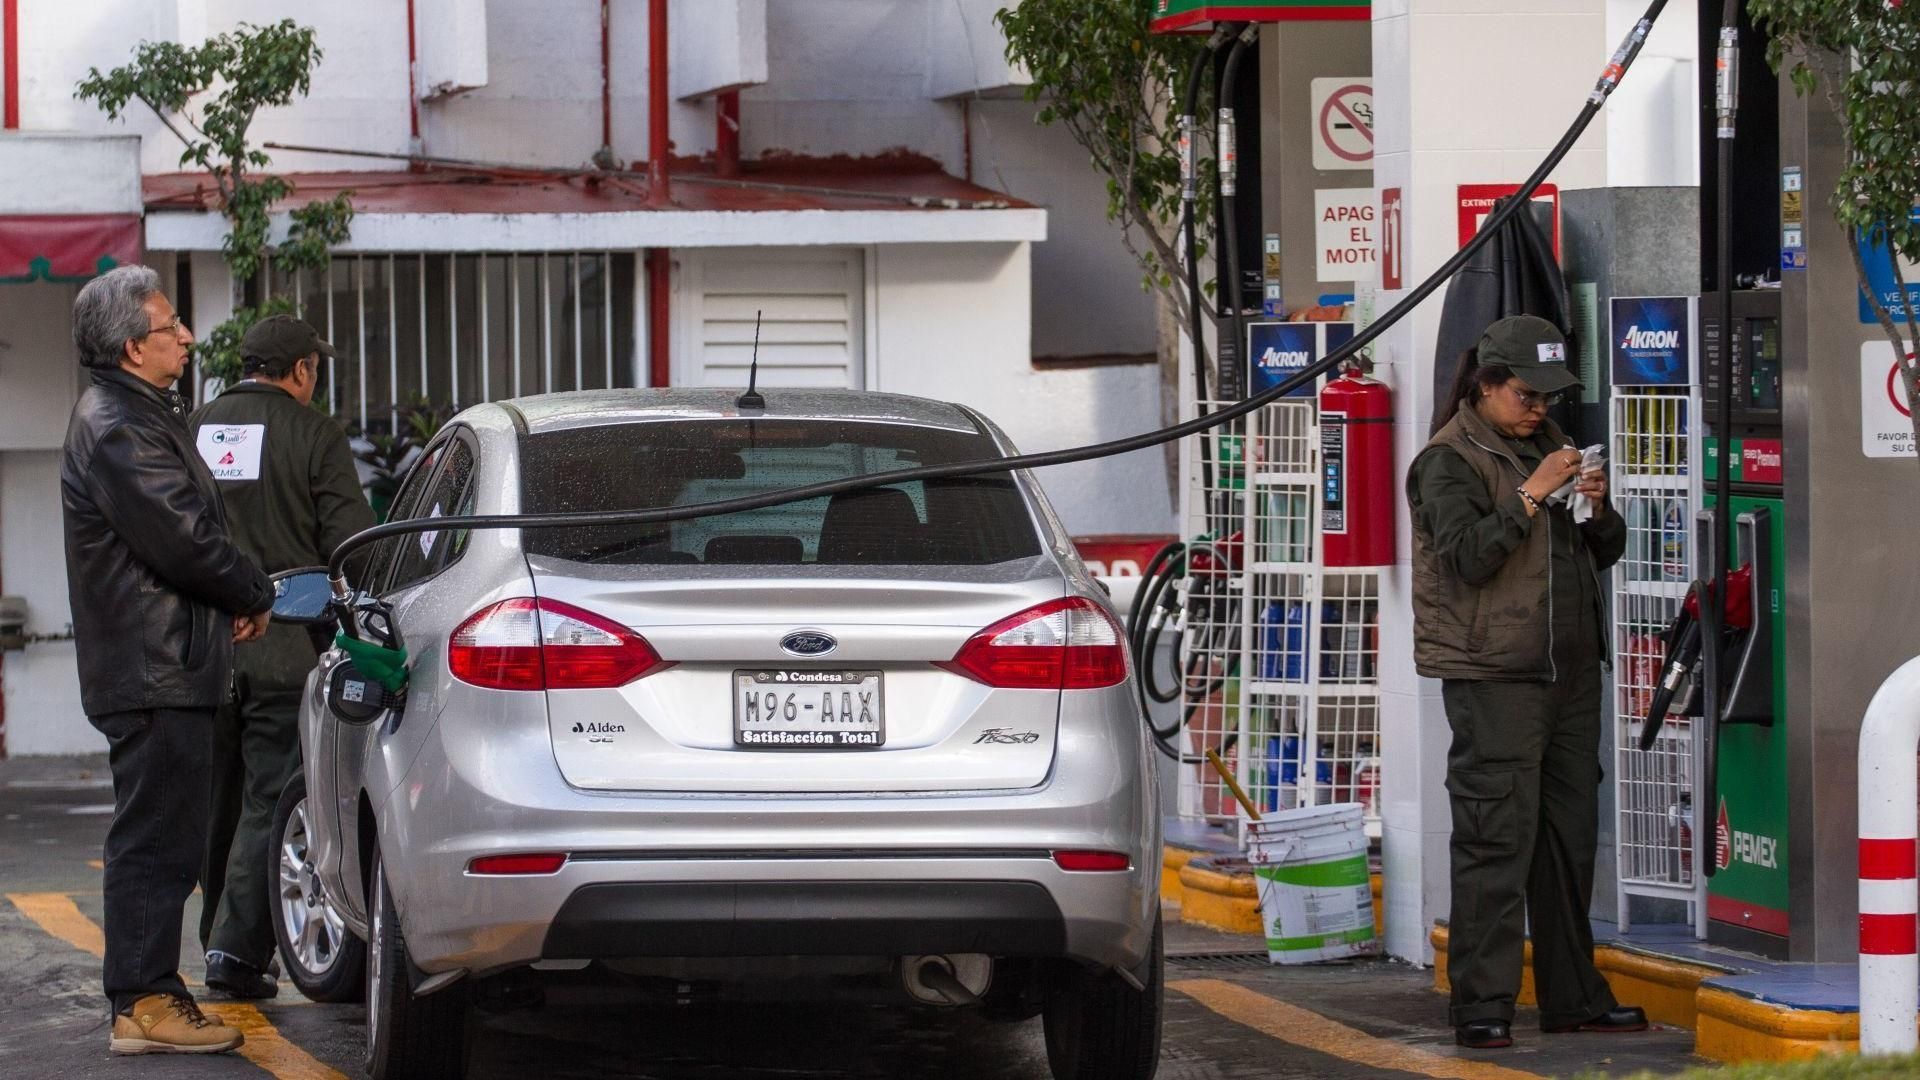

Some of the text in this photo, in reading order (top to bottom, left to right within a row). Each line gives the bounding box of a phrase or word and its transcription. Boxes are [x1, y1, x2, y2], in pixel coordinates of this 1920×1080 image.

[1350, 227, 1372, 242] EL
[1621, 325, 1679, 349] AKRON
[1258, 347, 1309, 367] AKRON
[1877, 432, 1908, 441] FAVOR
[1891, 444, 1905, 452] SU
[793, 635, 824, 651] Ford
[790, 672, 842, 682] Condesa
[745, 691, 873, 723] M96-AAX
[586, 722, 626, 733] Alden
[743, 731, 877, 744] Satisfacción Total
[1733, 830, 1777, 869] PEMEX
